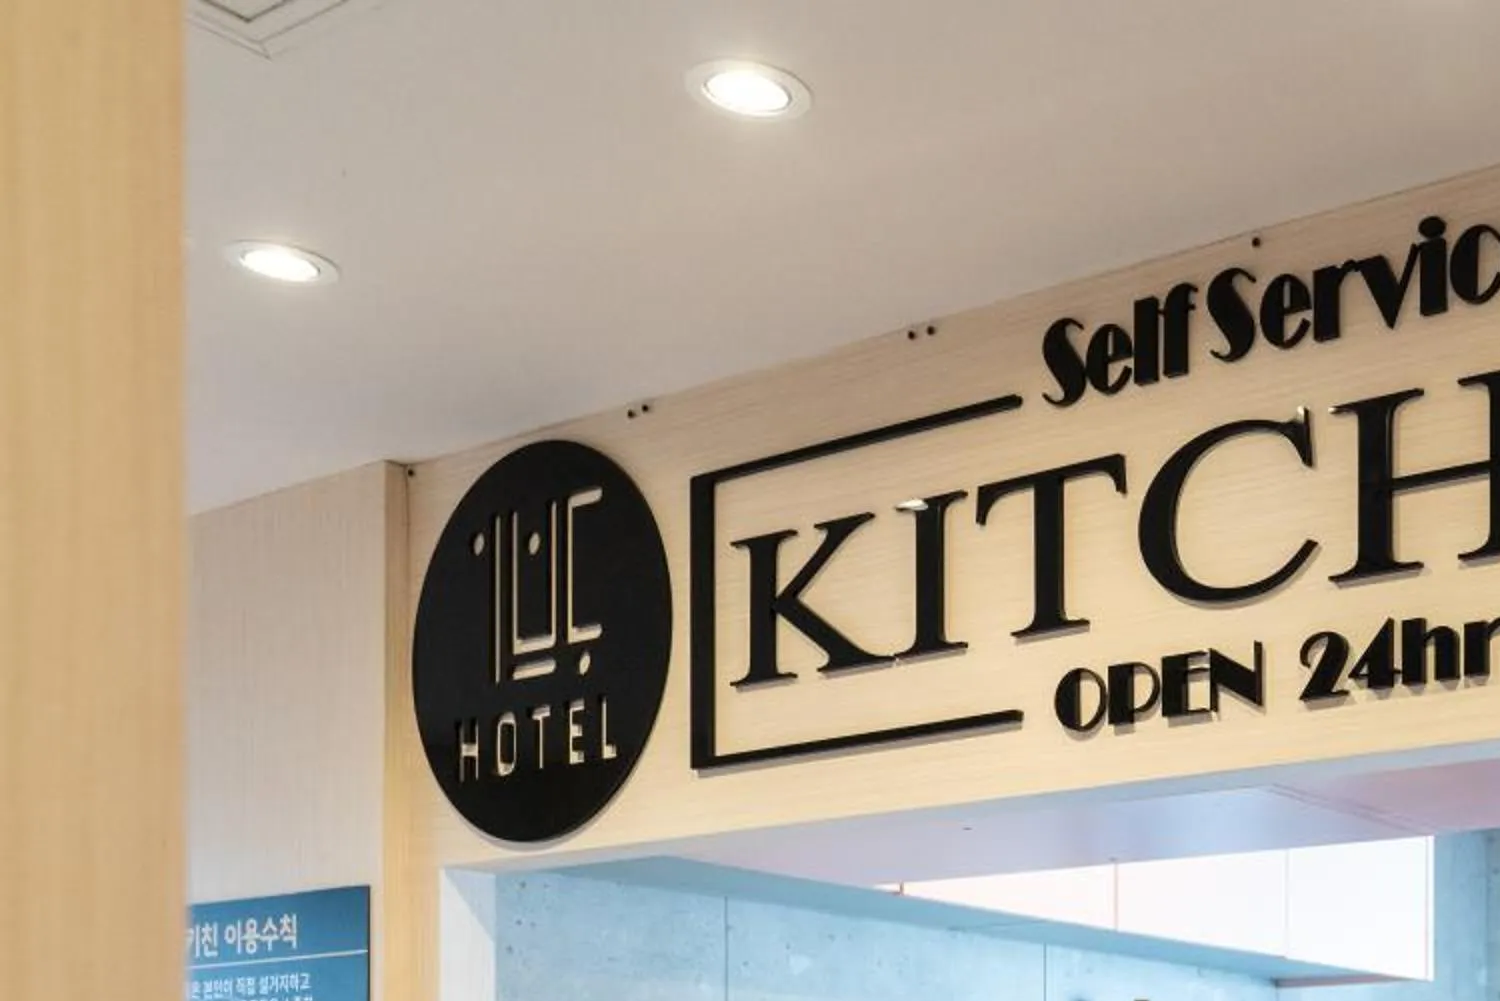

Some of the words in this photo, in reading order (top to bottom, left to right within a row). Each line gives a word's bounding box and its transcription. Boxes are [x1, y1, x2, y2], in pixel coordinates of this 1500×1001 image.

[1042, 281, 1198, 407] Self
[1055, 640, 1264, 732] OPEN
[459, 695, 617, 782] HOTEL
[224, 913, 297, 955] 이용수칙
